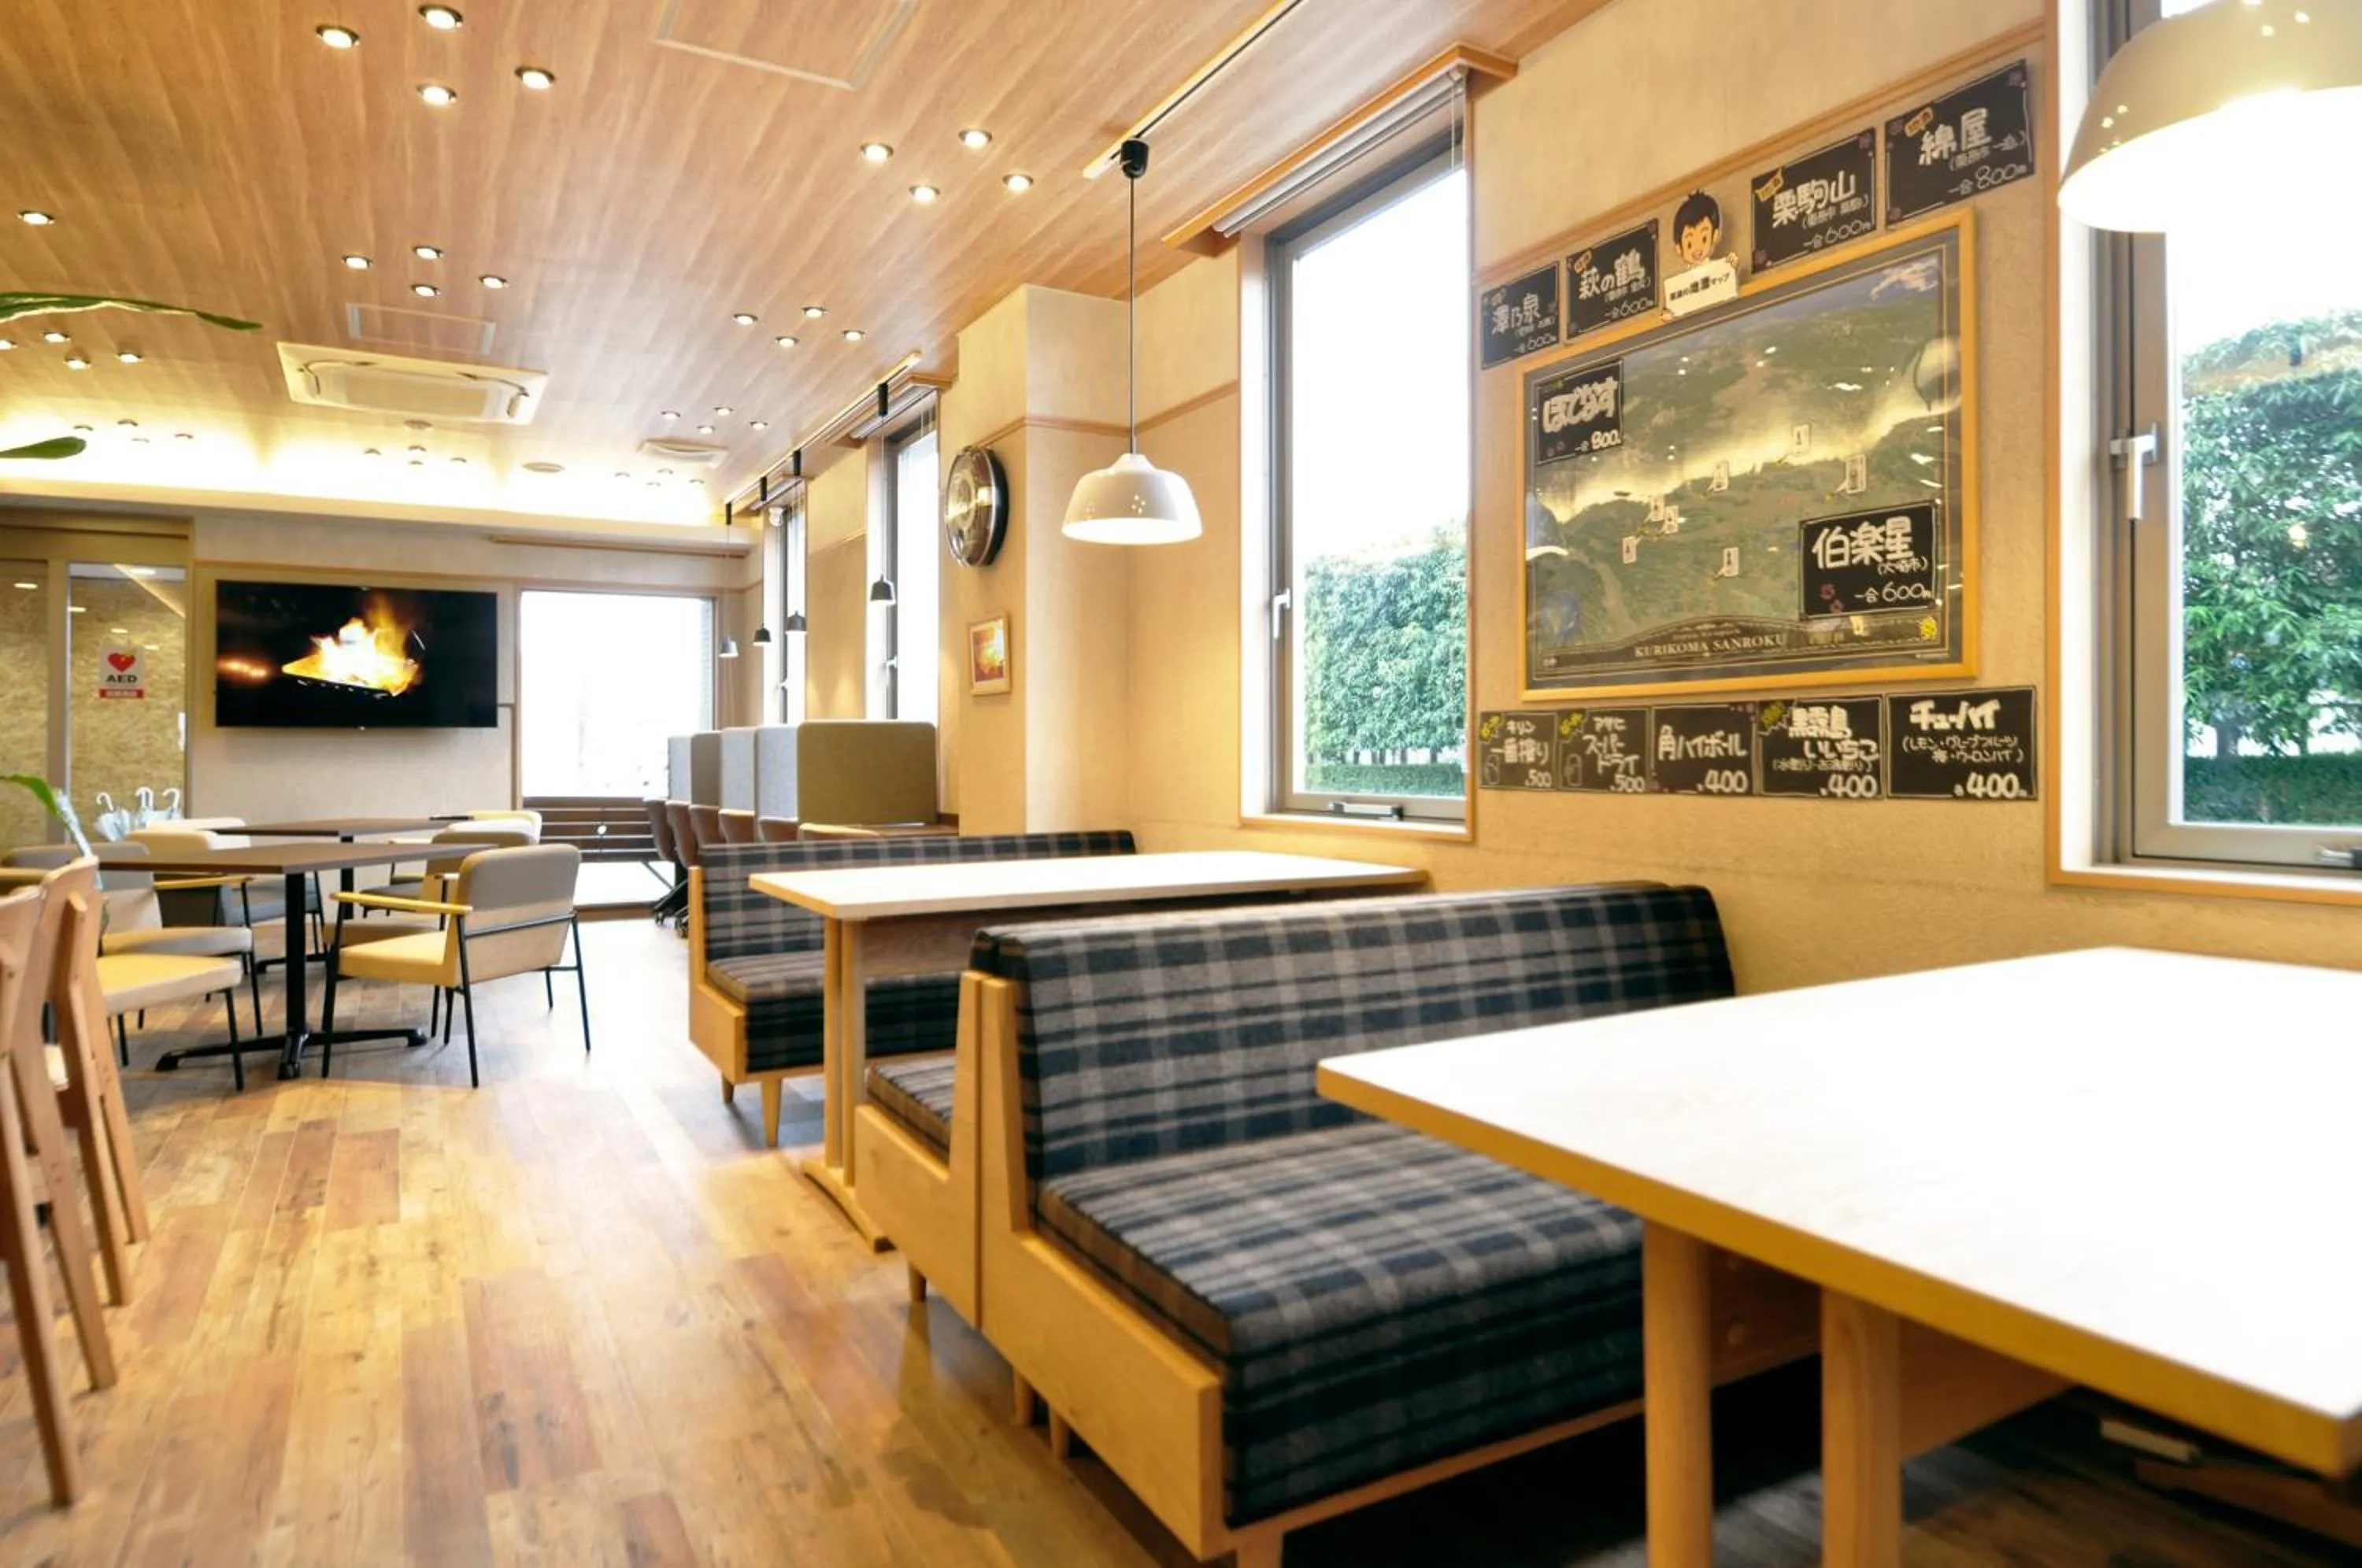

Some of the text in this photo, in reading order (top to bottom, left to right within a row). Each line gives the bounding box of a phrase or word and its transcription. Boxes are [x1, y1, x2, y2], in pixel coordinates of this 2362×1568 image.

[1919, 108, 1992, 165] 綿屋
[1772, 170, 1857, 228] 栗駒山
[1812, 516, 1915, 570] 伯楽星
[1635, 641, 1709, 657] KURIKOMA
[1712, 633, 1786, 651] SANROKU
[106, 674, 138, 684] AED
[1909, 699, 2001, 731] チューハイ
[1658, 724, 1747, 761] 角ハイボール
[1804, 738, 1880, 762] いいちこ
